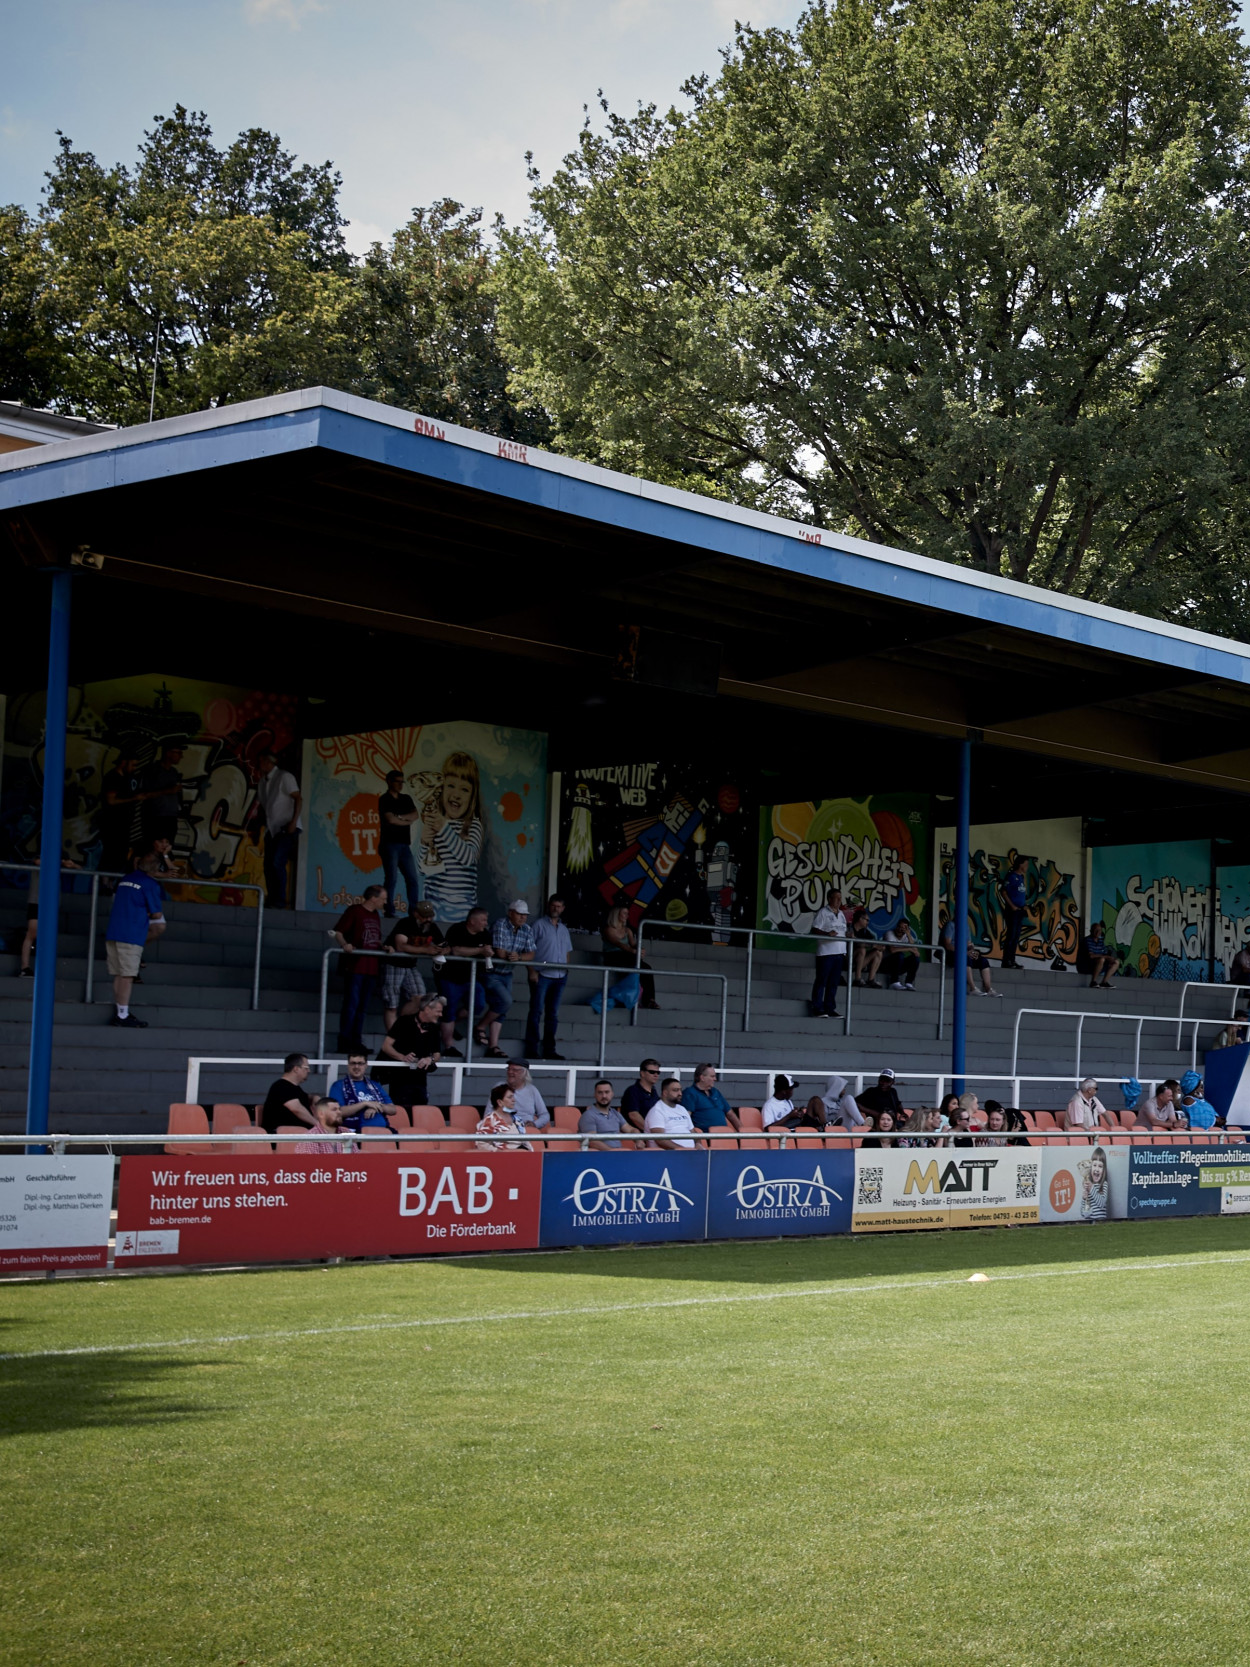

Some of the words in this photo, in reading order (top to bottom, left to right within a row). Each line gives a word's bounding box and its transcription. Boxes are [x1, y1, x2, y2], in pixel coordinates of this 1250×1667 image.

[620, 787, 647, 806] WEB
[350, 810, 364, 825] Go
[367, 810, 380, 824] fo
[768, 834, 914, 893] GESUNDHEIT
[1133, 1152, 1179, 1165] Volltreffer:
[1180, 1151, 1250, 1167] Pflegeimmobilien
[26, 1174, 77, 1182] Geschäftsführer
[152, 1170, 180, 1186] Wir
[184, 1170, 234, 1186] freuen
[239, 1172, 270, 1186] uns,
[274, 1169, 305, 1184] dass
[310, 1168, 331, 1183] die
[335, 1168, 367, 1183] Fans
[903, 1159, 998, 1195] MATT
[1132, 1172, 1191, 1188] Kapitalanlage
[1201, 1170, 1213, 1183] bis
[1214, 1172, 1224, 1182] zu
[150, 1194, 198, 1210] hinter
[202, 1196, 231, 1209] uns
[234, 1192, 288, 1208] stehen.
[892, 1198, 917, 1208] Heizung
[921, 1197, 941, 1206] Sanitär
[946, 1196, 981, 1205] Erneuerbare
[982, 1195, 1006, 1205] Energien
[1054, 1190, 1071, 1207] IT!
[1138, 1197, 1177, 1208] spechtgruppe.de
[150, 1215, 212, 1225] bab-bremen.de
[572, 1213, 643, 1227] IMMOBILIEN
[736, 1207, 798, 1220] IMMOBILIEN
[969, 1214, 992, 1222] Telefon:
[855, 1216, 944, 1227] www.matt-haustechnik.de
[427, 1225, 446, 1238] Die
[450, 1222, 516, 1237] Förderbank
[20, 1255, 40, 1263] fairen
[42, 1254, 59, 1262] Preis
[60, 1253, 101, 1263] angeboten!
